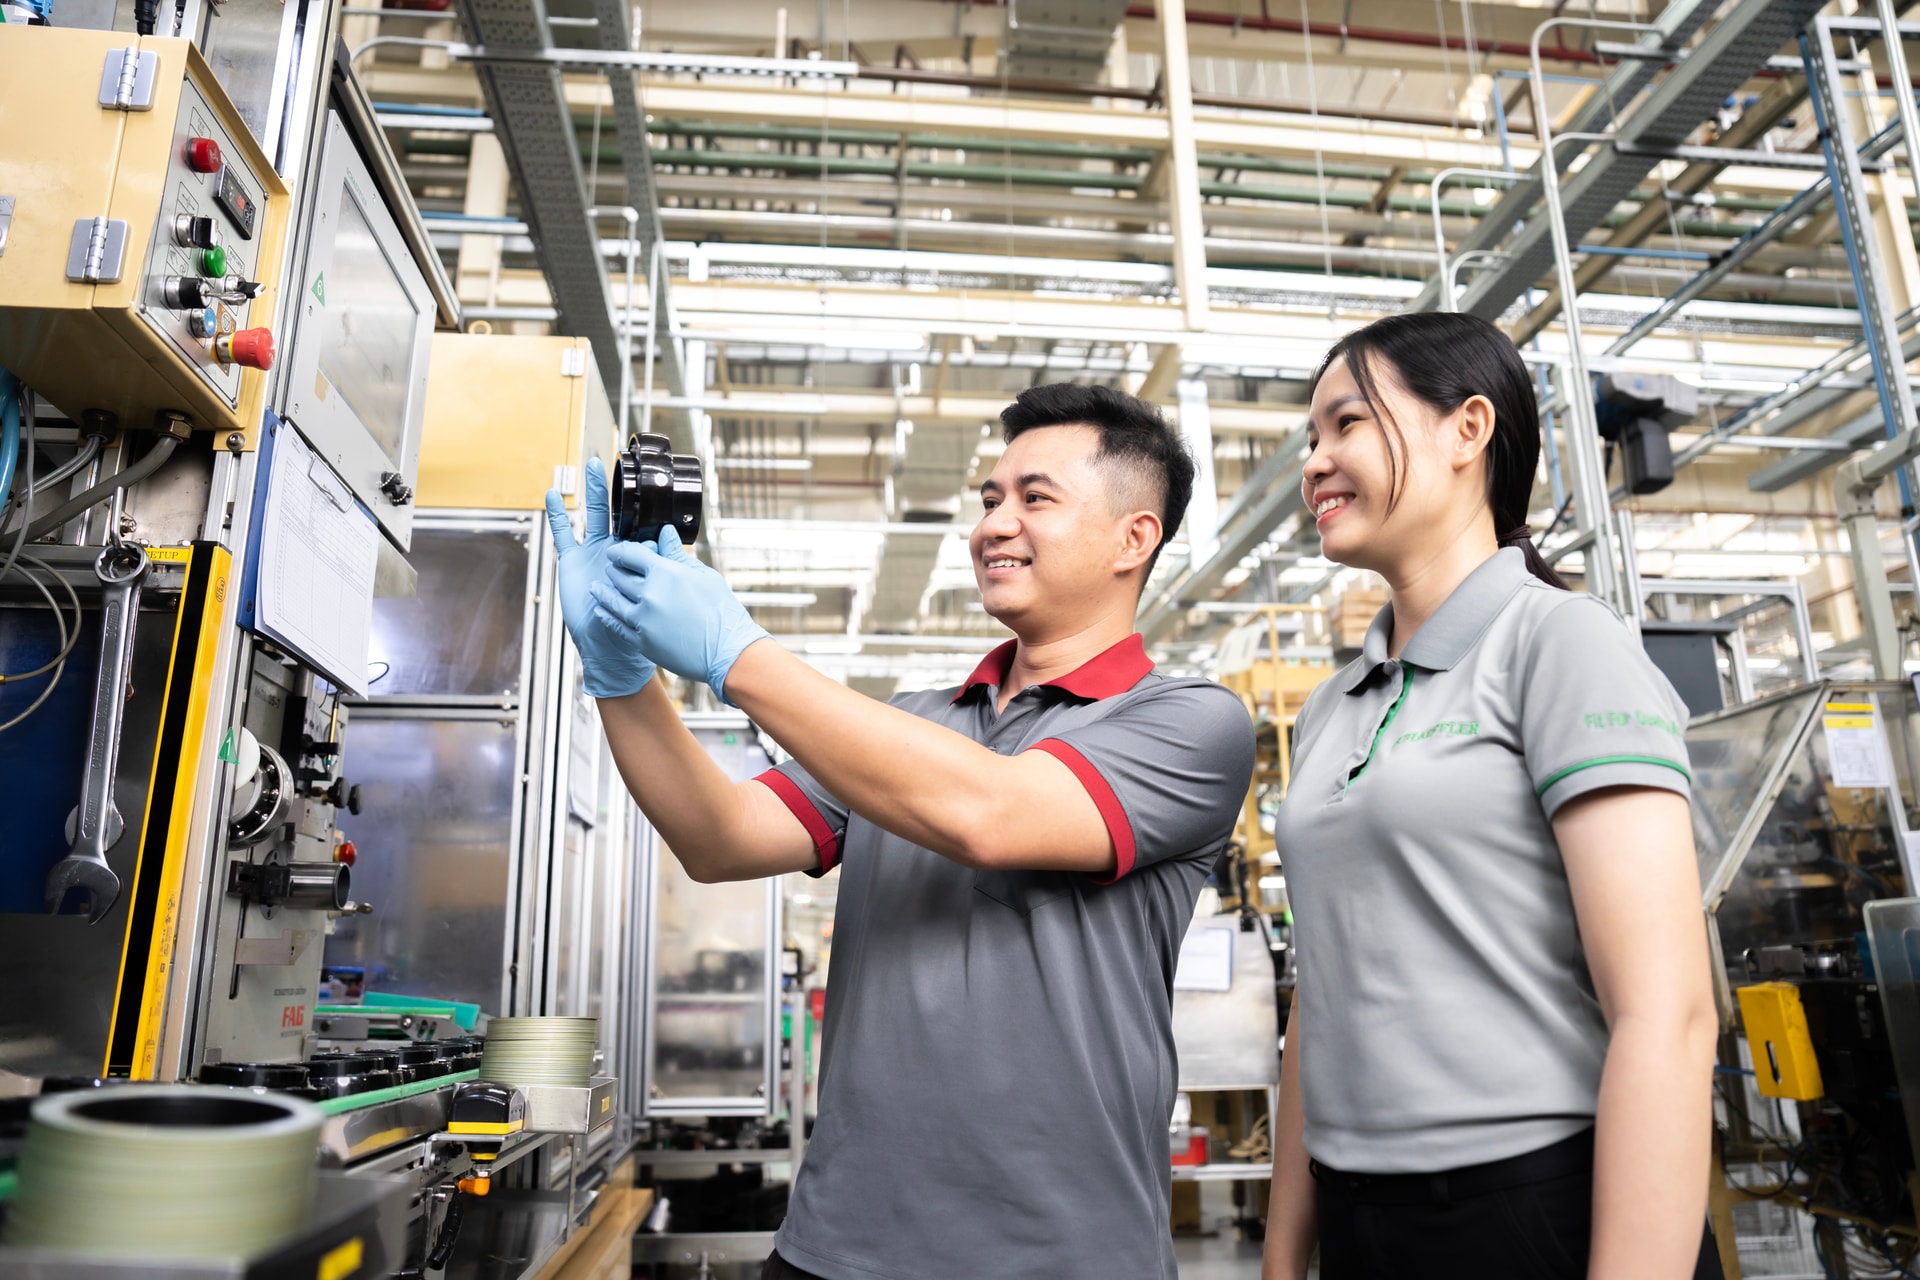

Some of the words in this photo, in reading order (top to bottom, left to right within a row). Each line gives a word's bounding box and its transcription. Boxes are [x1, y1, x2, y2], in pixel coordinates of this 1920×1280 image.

[316, 279, 323, 296] 6
[226, 736, 232, 756] 1
[281, 1005, 305, 1028] FAG
